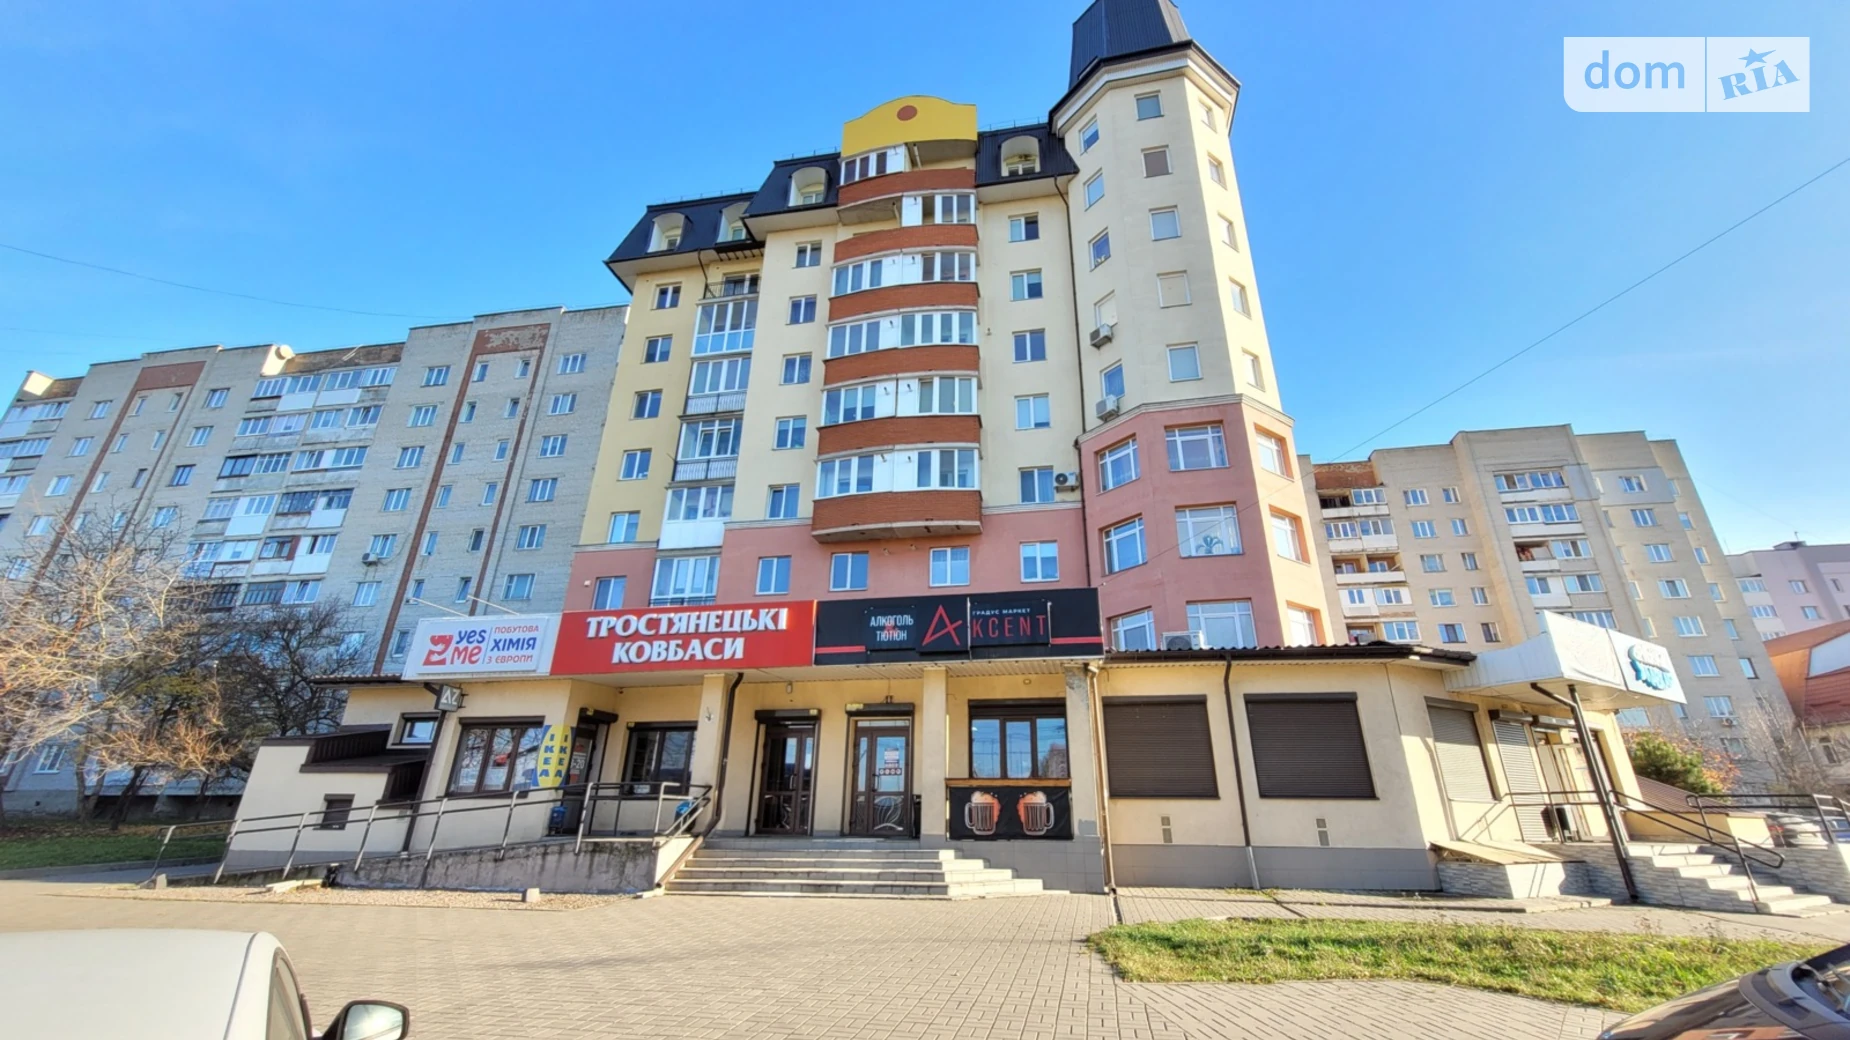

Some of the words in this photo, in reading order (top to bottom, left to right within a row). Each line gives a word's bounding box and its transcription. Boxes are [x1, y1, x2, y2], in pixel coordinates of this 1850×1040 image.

[586, 607, 788, 638] ТРОСТЯНЕЦЬКІ
[870, 614, 914, 627] АЛКОГОЛЬ
[494, 625, 539, 633] ПОБУТОВА
[876, 630, 907, 641] ТЮТЮН
[490, 637, 537, 652] ХІМІЯ
[611, 637, 745, 664] КОВБАСИ
